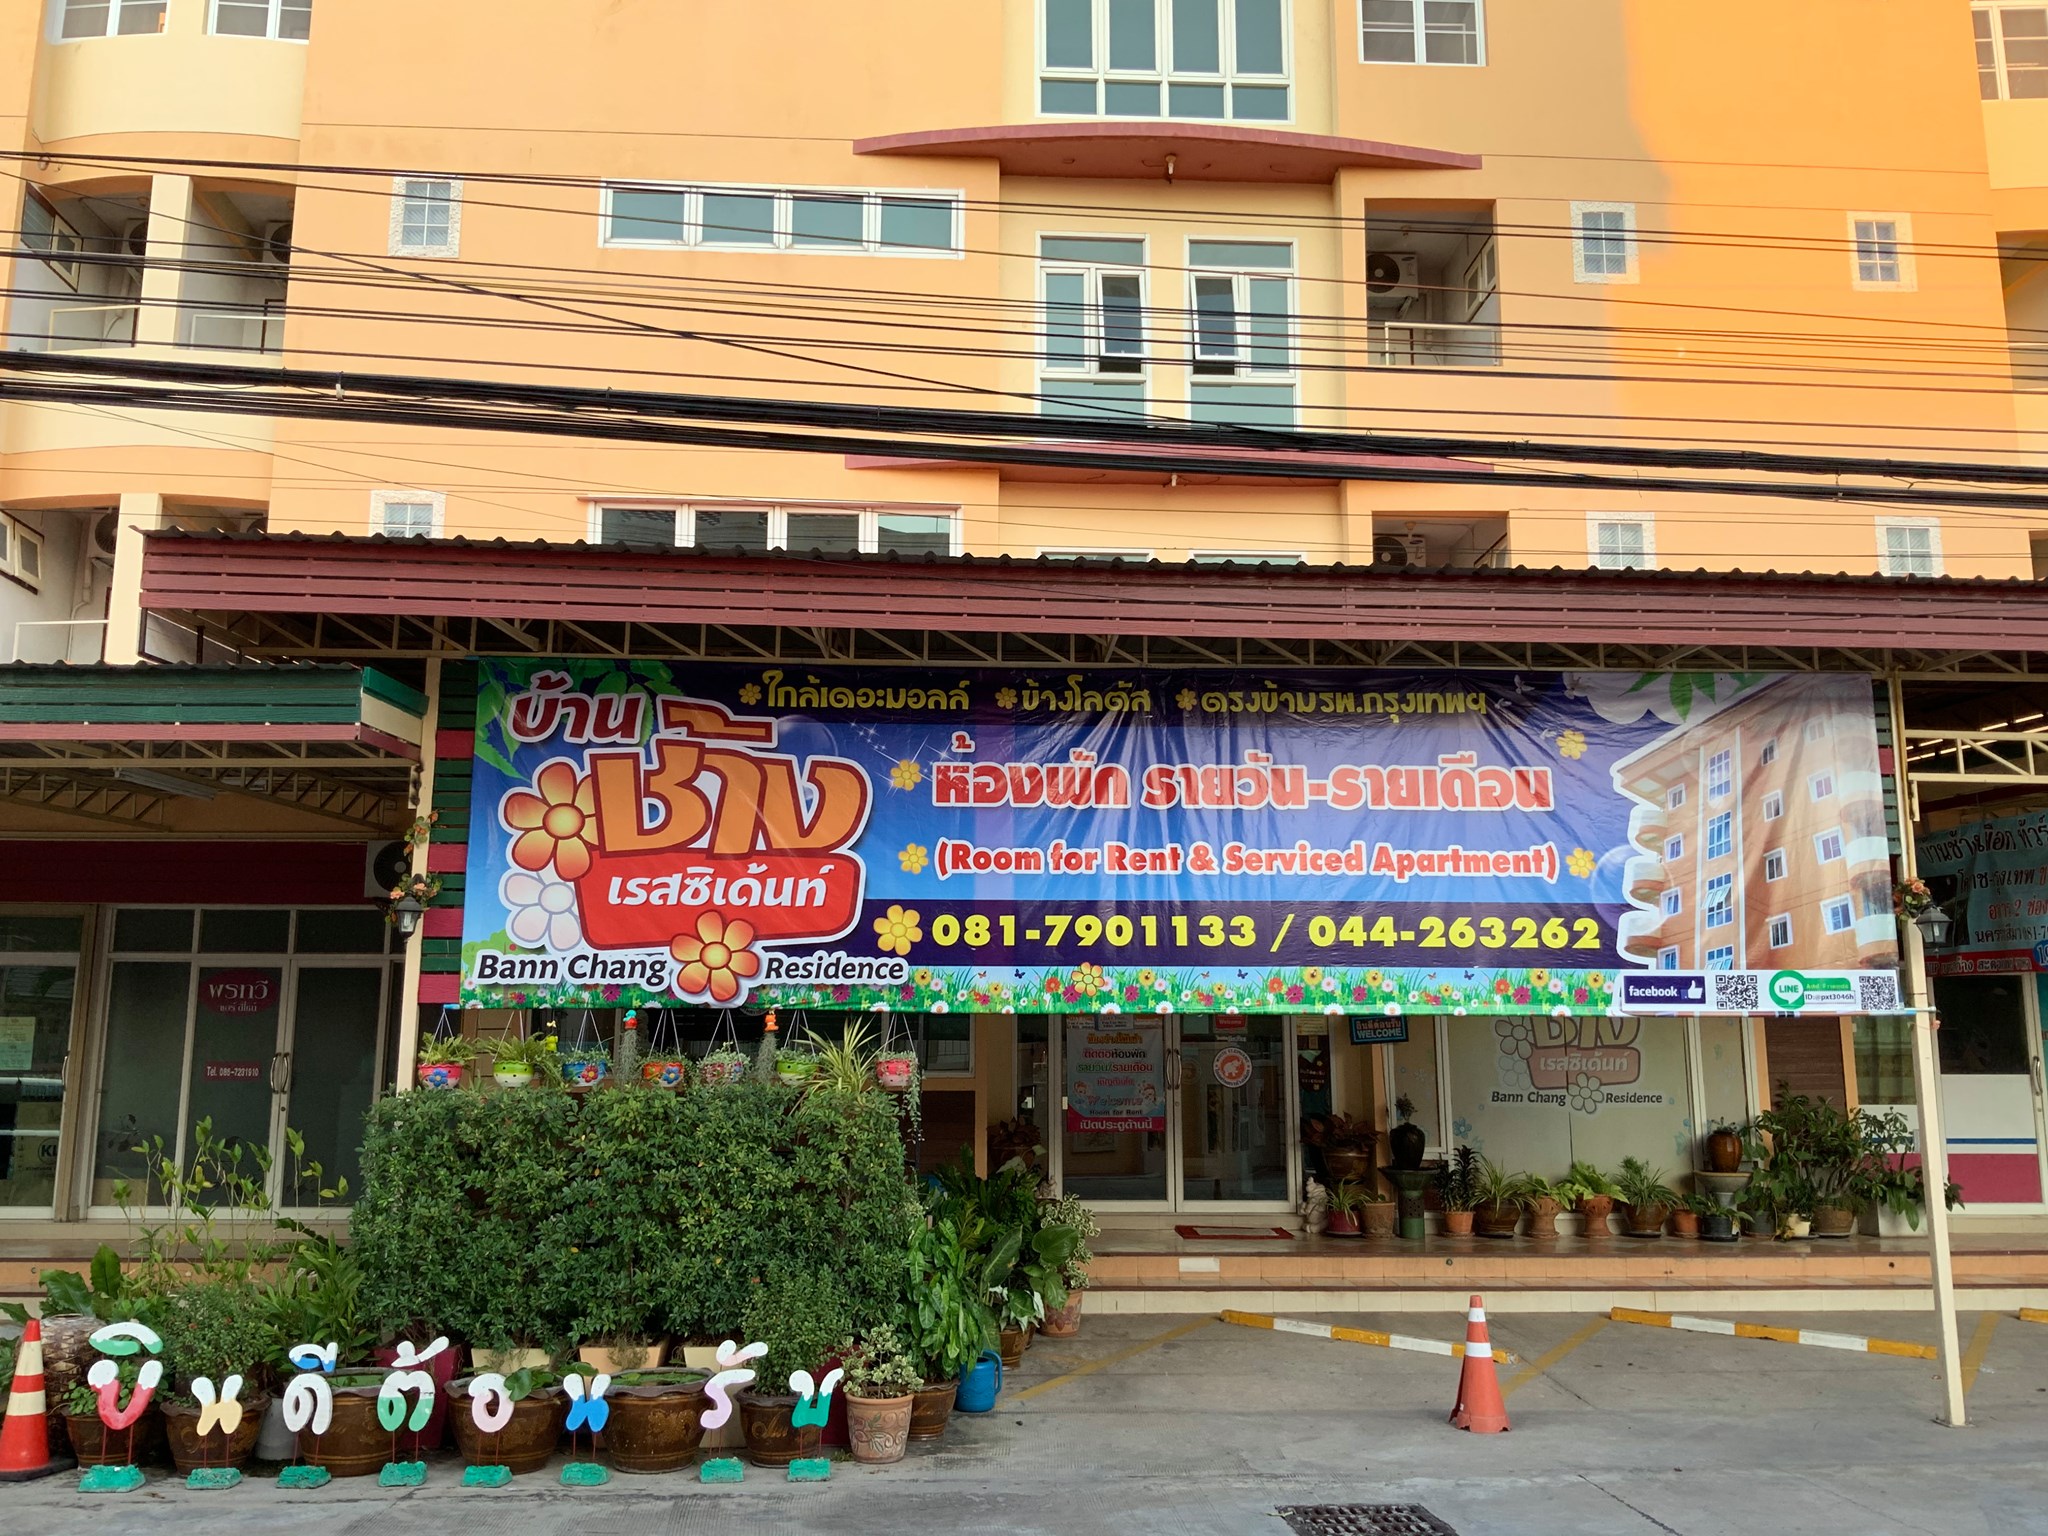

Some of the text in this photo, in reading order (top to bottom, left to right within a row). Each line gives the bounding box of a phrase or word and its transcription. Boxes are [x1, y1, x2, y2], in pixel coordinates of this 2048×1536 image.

[510, 672, 645, 743] บ้าน
[762, 670, 971, 710] ใกล้เดอะมอลล์
[1021, 675, 1151, 713] ข้างโลตัส
[589, 697, 870, 860] ช้าง
[934, 733, 1553, 809] ห้องพัก รายวัน-รายเดือน
[937, 840, 1558, 882] (Room for Rent & Serviced Apartment)
[607, 862, 838, 908] เรสซิเด้นท์
[930, 913, 1258, 948] 081-7901133
[1307, 915, 1602, 950] 044-263262
[478, 953, 904, 986] Bann Chang Residence
[1628, 983, 1678, 999] facebook
[1778, 984, 1799, 994] LINE
[1356, 1027, 1403, 1039] WELCOME
[1539, 1050, 1631, 1072] เรสซิเด้นท์
[1491, 1091, 1663, 1106] Bann Chang Residence
